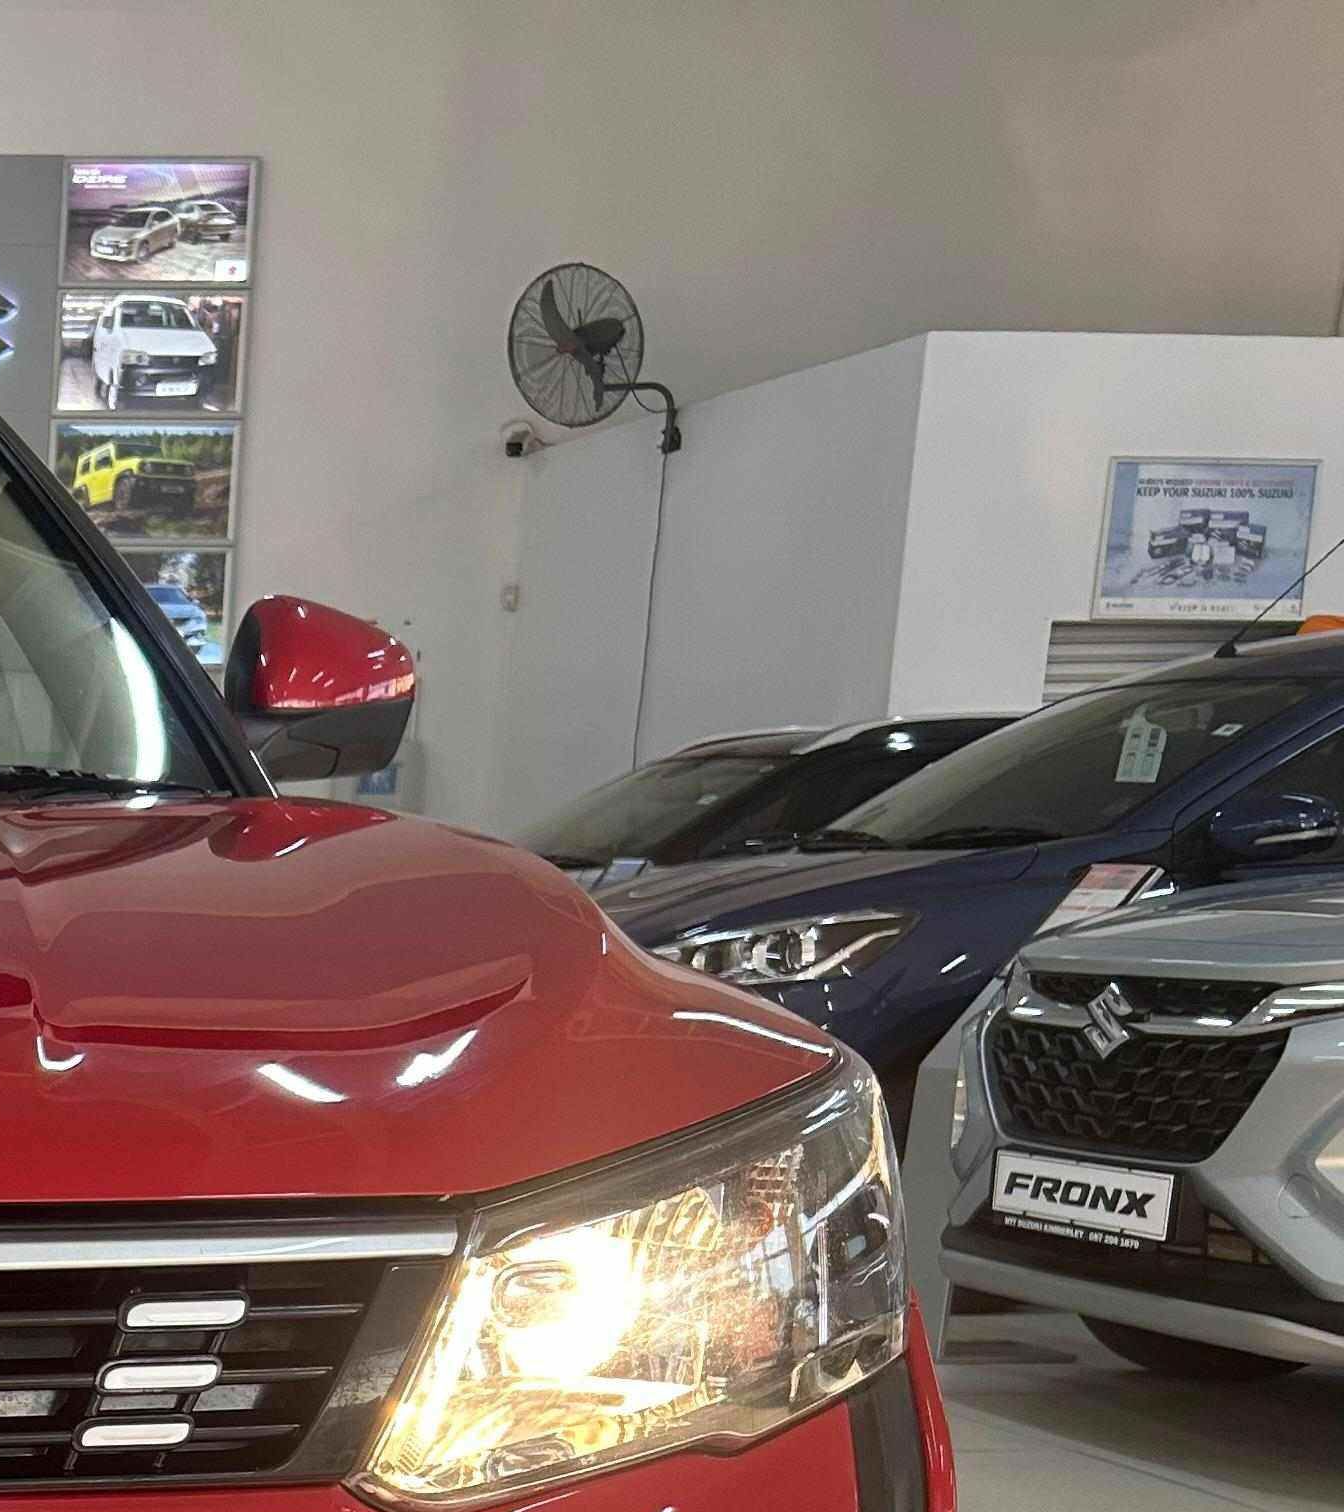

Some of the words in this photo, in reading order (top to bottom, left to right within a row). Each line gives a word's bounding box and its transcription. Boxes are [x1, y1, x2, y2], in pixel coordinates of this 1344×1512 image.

[1136, 487, 1161, 497] KEEP
[1163, 487, 1189, 497] YOUR
[1191, 487, 1227, 498] SUZUKI
[1230, 488, 1255, 498] 100%
[1257, 488, 1294, 499] SUZUKI
[1004, 1172, 1155, 1218] FRONX
